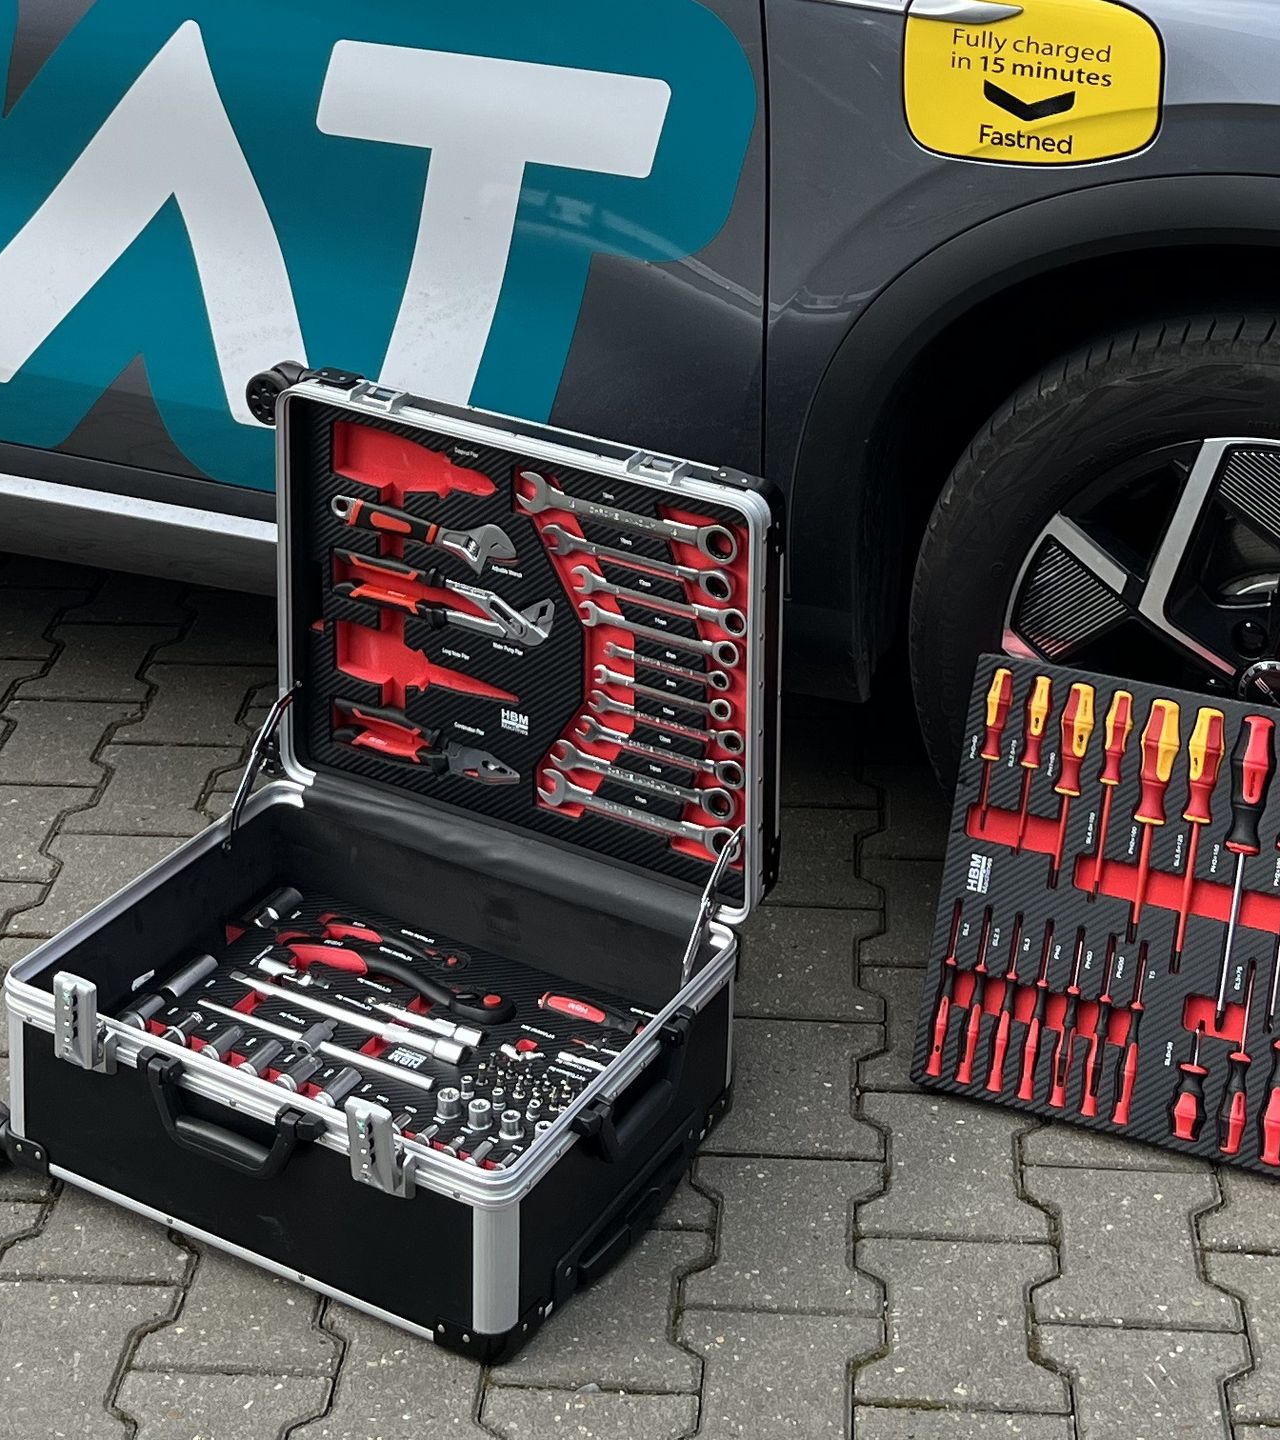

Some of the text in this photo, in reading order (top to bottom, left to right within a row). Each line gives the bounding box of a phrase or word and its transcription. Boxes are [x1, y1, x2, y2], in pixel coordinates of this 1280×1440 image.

[953, 28, 1112, 65] Fully charged
[951, 51, 1112, 88] in 15 minutes
[979, 124, 1073, 155] Fastned
[501, 708, 529, 725] HBM
[966, 853, 982, 893] HBM
